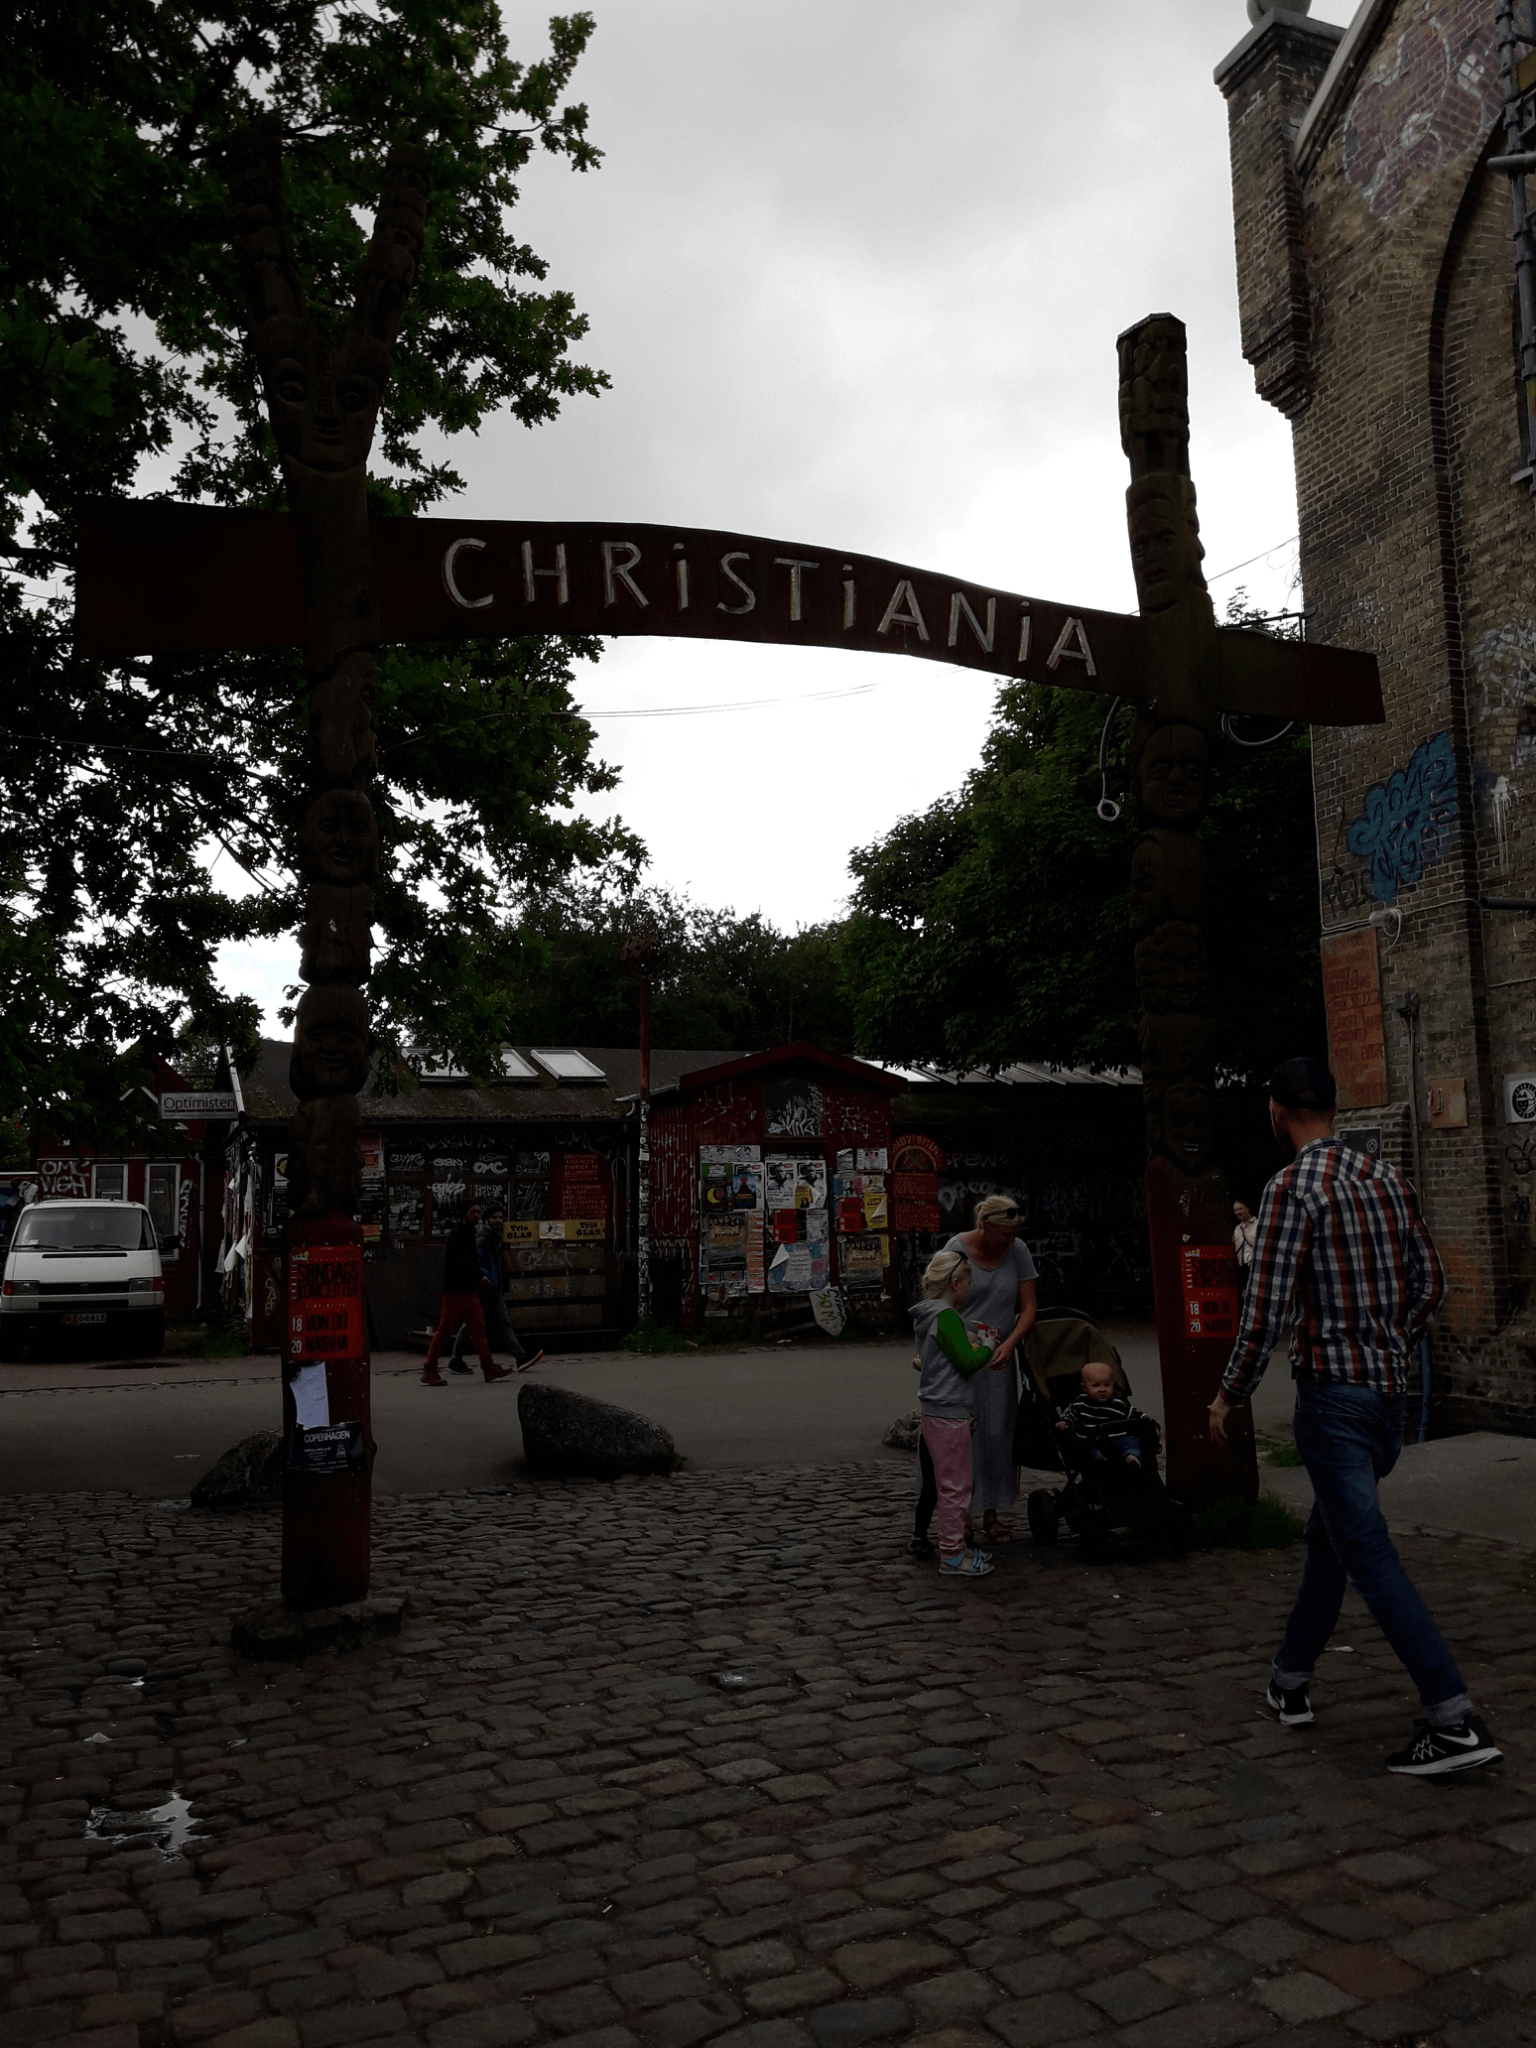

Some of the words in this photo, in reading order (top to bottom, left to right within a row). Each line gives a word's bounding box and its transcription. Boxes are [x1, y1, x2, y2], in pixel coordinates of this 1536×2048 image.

[164, 1097, 235, 1109] Optimisten
[298, 1262, 358, 1282] SØNDAGS
[1190, 1303, 1199, 1315] 18
[292, 1318, 302, 1331] 18
[1190, 1321, 1201, 1333] 20
[292, 1340, 302, 1354] 20
[304, 1430, 351, 1443] COPENHAGEN
